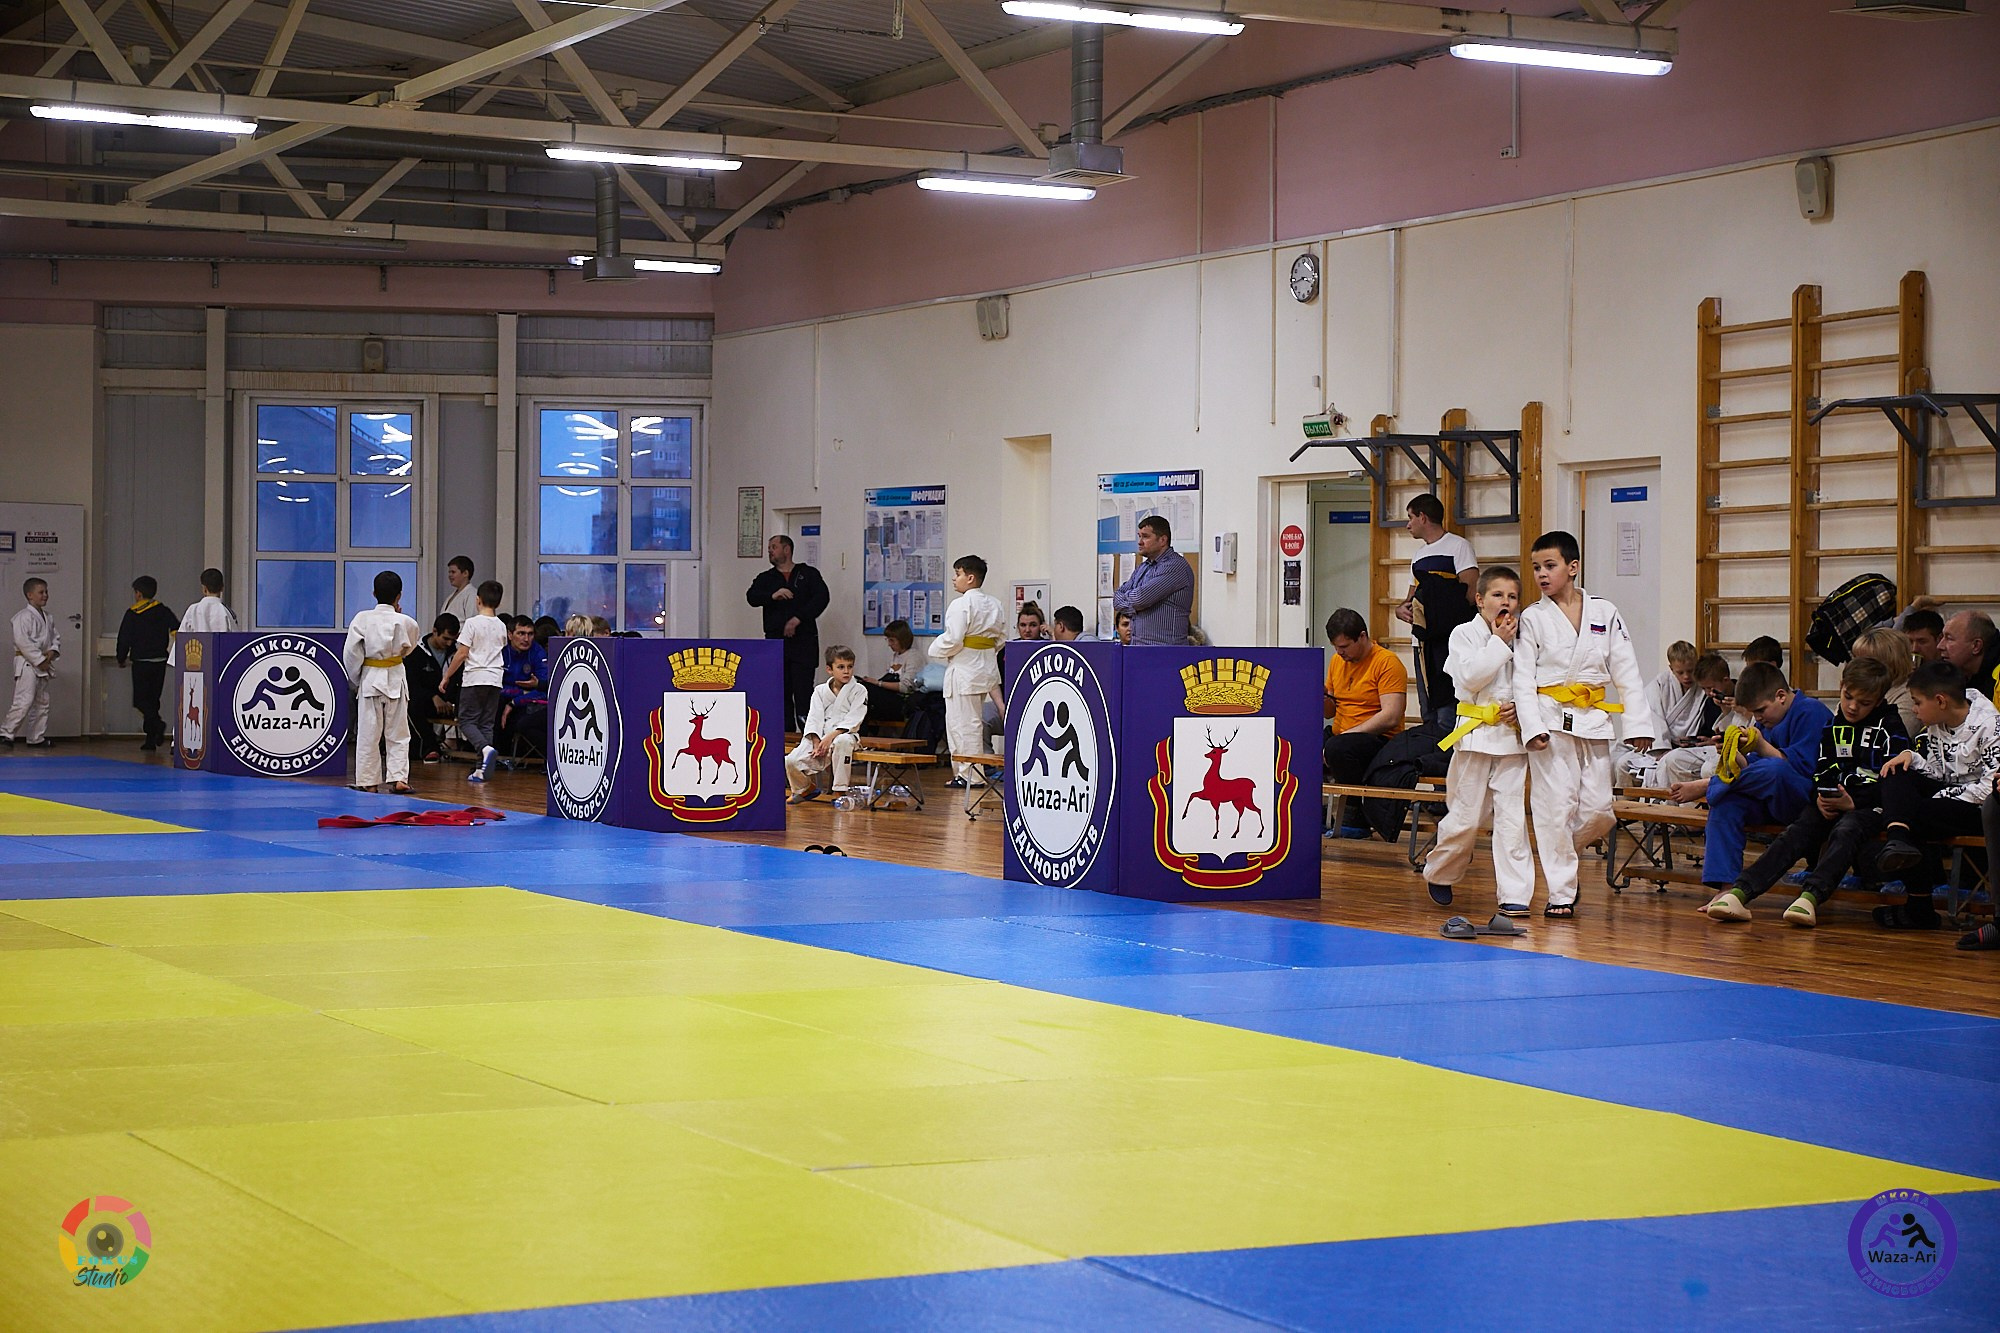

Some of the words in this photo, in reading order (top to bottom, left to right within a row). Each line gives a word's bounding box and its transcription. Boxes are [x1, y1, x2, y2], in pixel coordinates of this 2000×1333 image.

[1304, 424, 1330, 435] ВЫХОД
[1158, 474, 1196, 487] ИНФОРМАЦИЯ
[911, 490, 945, 502] ИНФОРМАЦИЯ
[251, 639, 317, 658] ШКОЛА
[563, 645, 599, 671] ШКОЛА
[1029, 653, 1084, 687] ШКОЛА
[241, 712, 325, 730] Waza-Ari
[230, 734, 337, 771] ЕДИНОБОРСТВ
[558, 742, 603, 767] Waza-Ari
[552, 769, 610, 819] ЕДИНОБОРСТВ
[1021, 780, 1090, 814] Waza-Ari
[1012, 815, 1098, 881] ЕДИНОБОРСТВ
